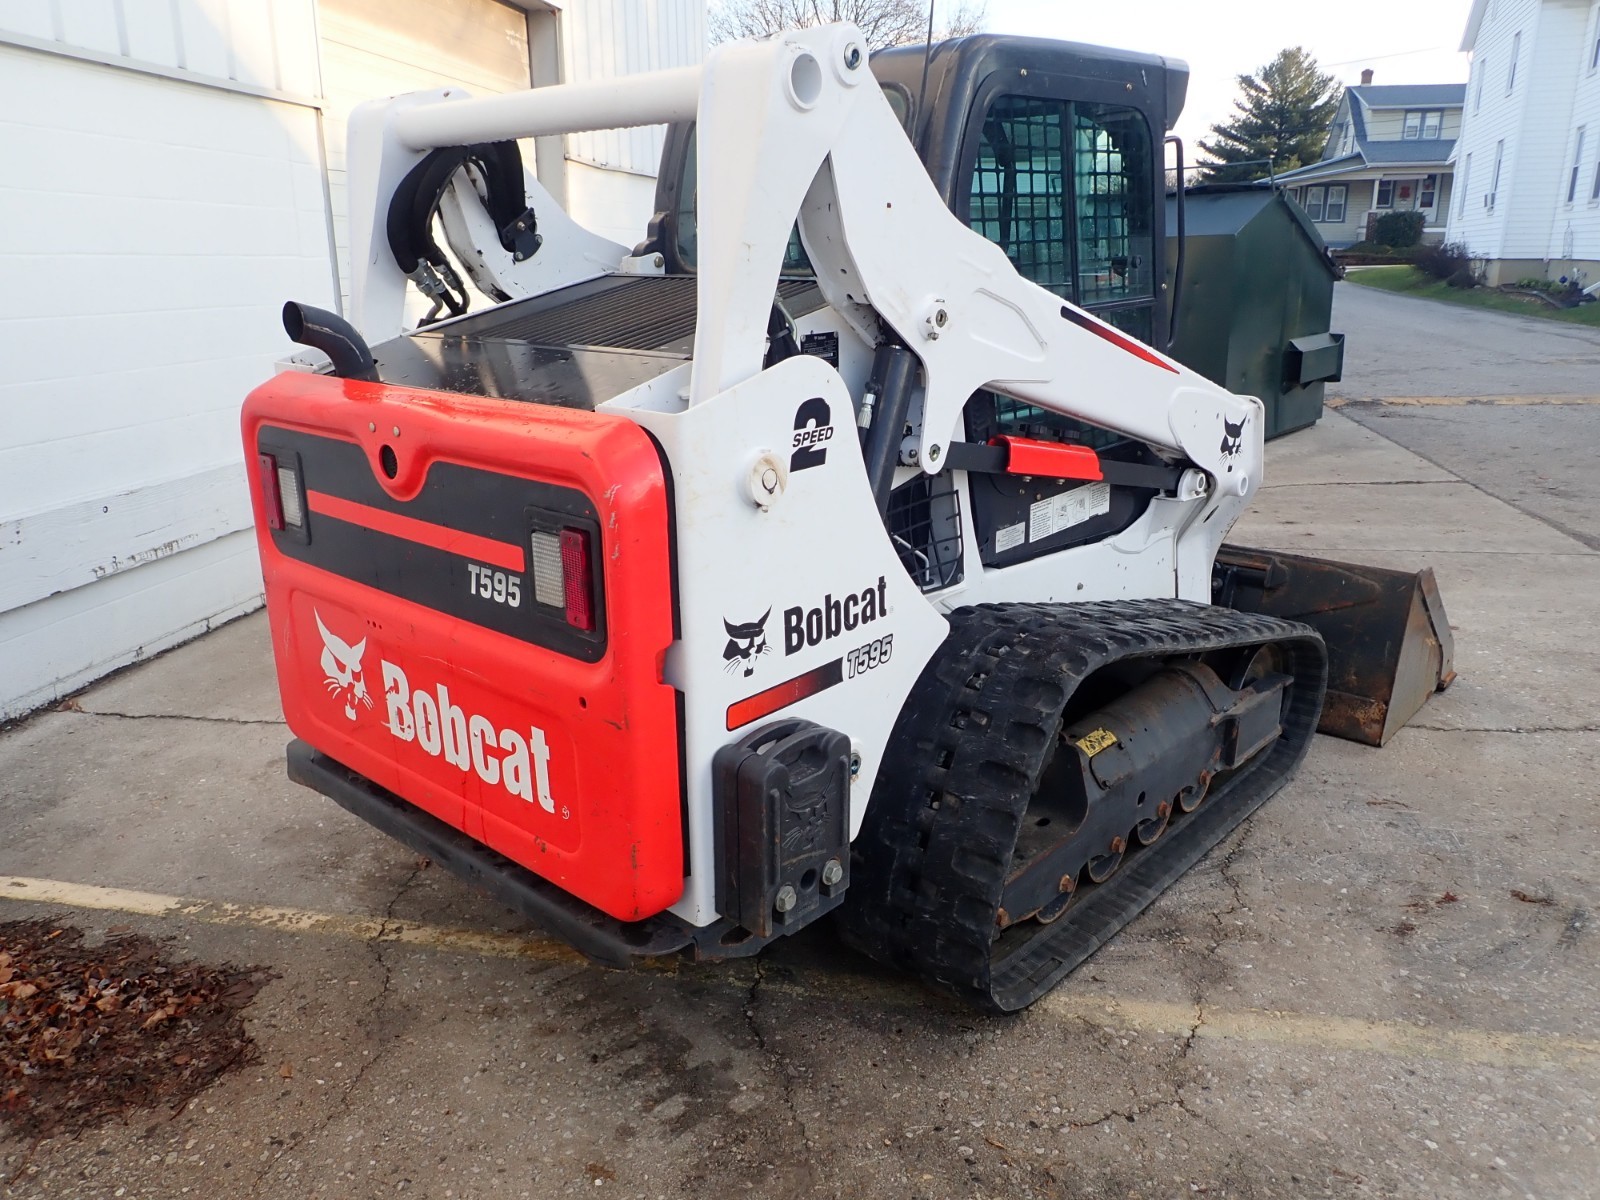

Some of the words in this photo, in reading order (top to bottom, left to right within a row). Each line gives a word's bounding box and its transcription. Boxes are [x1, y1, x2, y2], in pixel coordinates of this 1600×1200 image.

[789, 397, 831, 473] 2
[792, 426, 834, 448] SPEED
[468, 563, 521, 608] T595
[783, 575, 887, 656] Bobcat
[847, 633, 894, 680] T595
[381, 659, 555, 814] Bobcat
